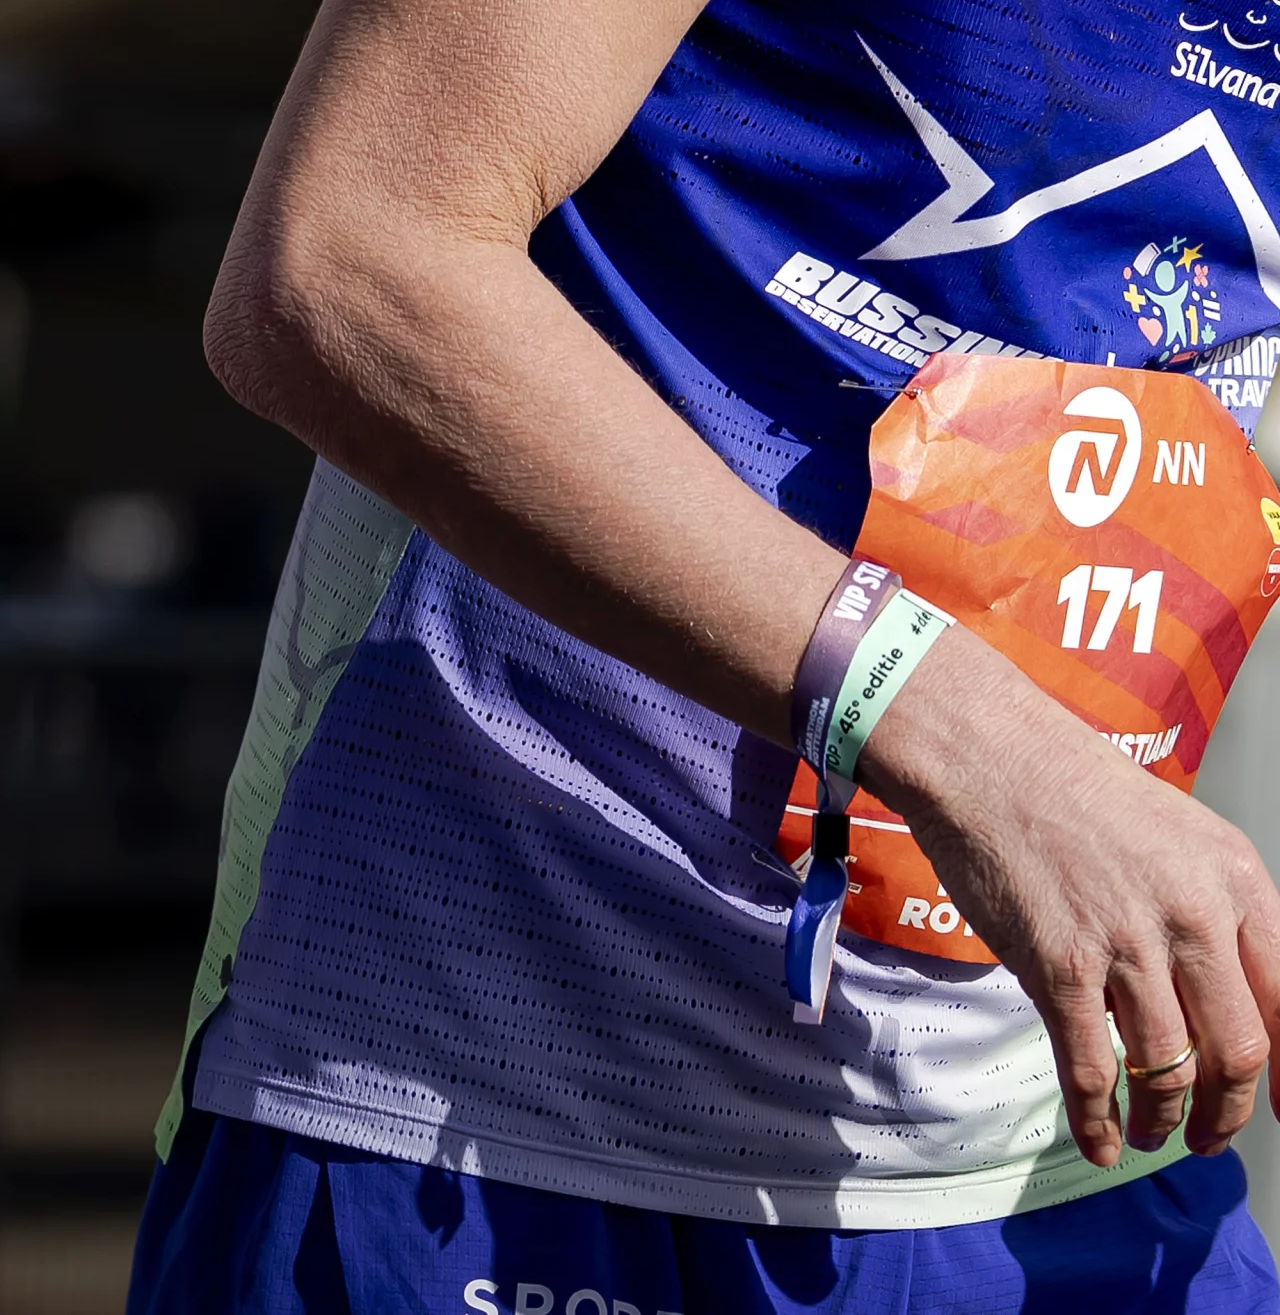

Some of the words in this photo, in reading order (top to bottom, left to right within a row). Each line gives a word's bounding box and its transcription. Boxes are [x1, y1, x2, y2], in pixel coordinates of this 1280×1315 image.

[765, 280, 931, 369] OBSERVATION
[773, 251, 1065, 363] BUSSI
[1207, 378, 1273, 408] TRAV
[1152, 439, 1206, 487] NN
[832, 584, 872, 622] VIP
[1056, 564, 1165, 655] 171
[862, 647, 904, 700] editie
[910, 609, 933, 636] #de
[1098, 722, 1183, 766] STIAAN
